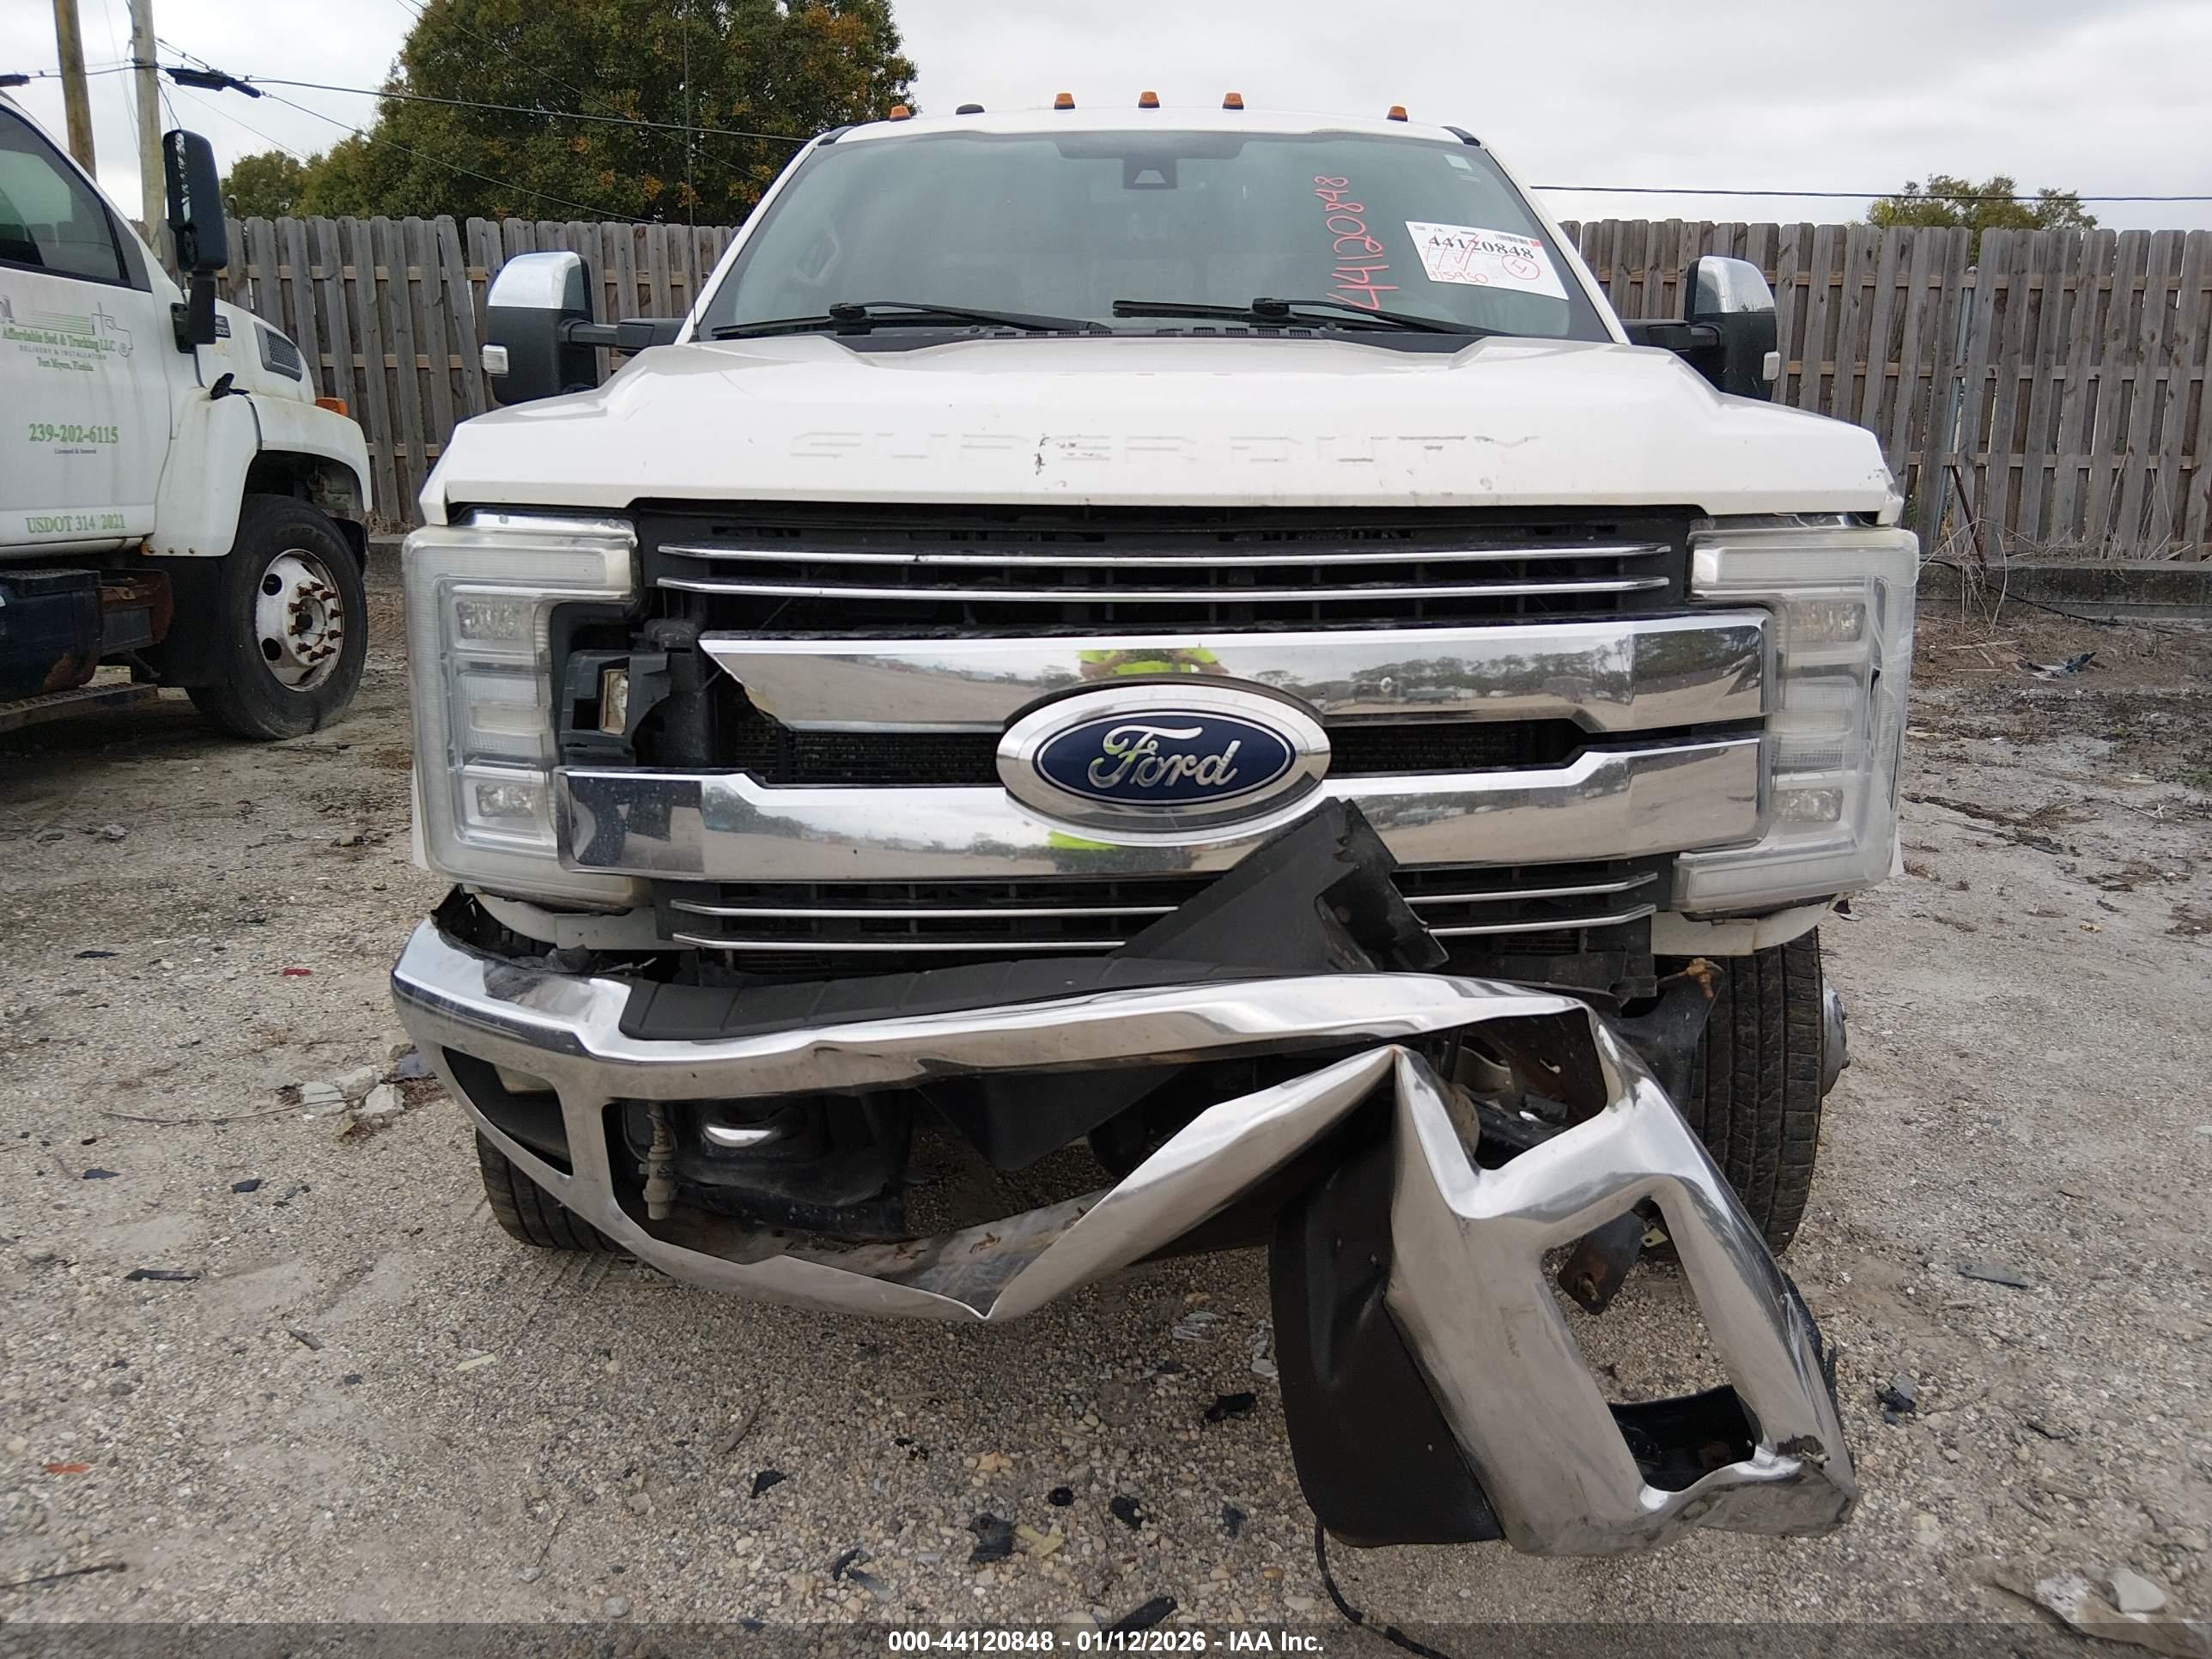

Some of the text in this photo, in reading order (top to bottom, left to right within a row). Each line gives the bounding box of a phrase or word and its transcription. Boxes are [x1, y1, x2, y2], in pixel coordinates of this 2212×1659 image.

[1314, 175, 1401, 311] 44120848
[1428, 234, 1535, 259] 44120848
[99, 338, 117, 352] LLC
[28, 422, 119, 444] 239-202-6115
[788, 431, 1540, 465] SUPER DUTY
[26, 516, 74, 534] USDOT
[1087, 724, 1242, 789] Ford
